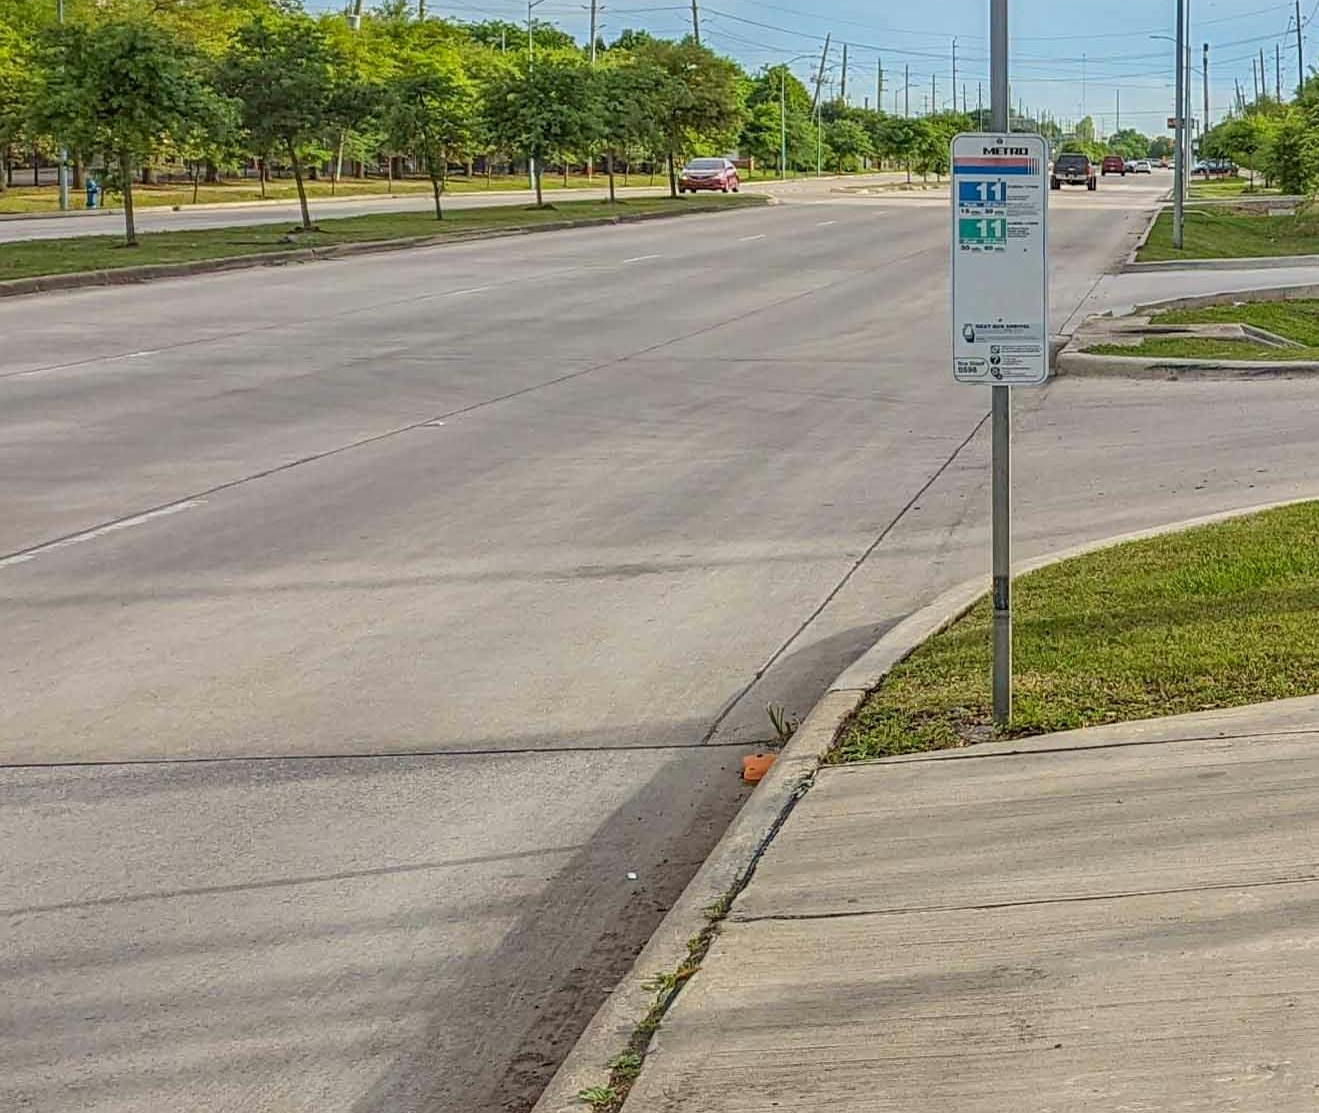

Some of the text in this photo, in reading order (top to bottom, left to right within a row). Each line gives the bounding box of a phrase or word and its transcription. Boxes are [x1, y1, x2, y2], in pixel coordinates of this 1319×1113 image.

[982, 147, 1029, 155] METRO
[976, 183, 1002, 200] 11
[976, 220, 1002, 237] 11
